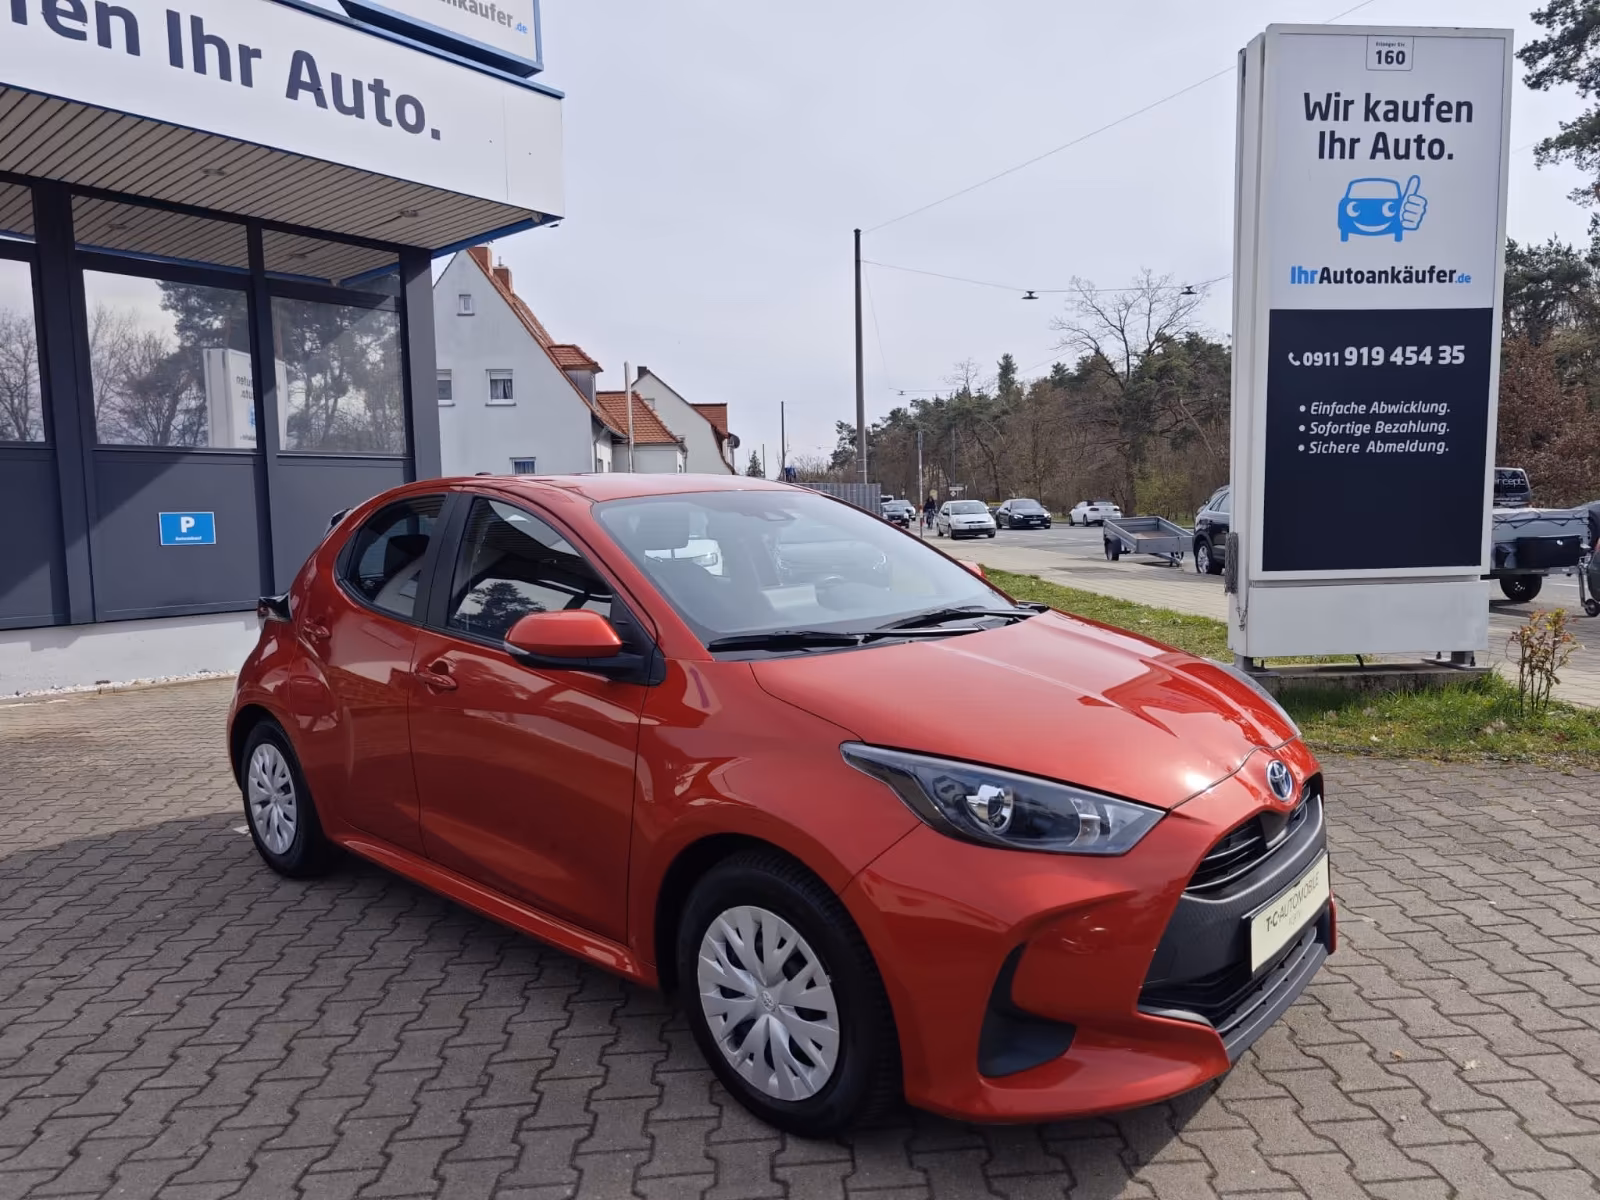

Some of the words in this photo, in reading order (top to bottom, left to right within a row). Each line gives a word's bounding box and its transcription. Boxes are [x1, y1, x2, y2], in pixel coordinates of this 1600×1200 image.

[1376, 50, 1406, 65] 160
[166, 9, 262, 88] Ihr
[286, 49, 441, 141] Auto.
[1303, 92, 1355, 122] Wir
[1364, 92, 1473, 123] kaufen
[1318, 130, 1361, 160] Ihr
[1369, 131, 1454, 160] Auto.
[1290, 265, 1472, 285] IhrAutoankäufer.de
[1302, 352, 1340, 367] 0911
[1344, 346, 1385, 366] 919
[1389, 346, 1433, 366] 454
[1438, 345, 1466, 365] 35
[1310, 402, 1367, 417] Einfache
[1369, 401, 1451, 416] Abwicklung.
[1309, 421, 1371, 437] Sofortige
[1374, 420, 1450, 435] Bezahlung.
[1309, 441, 1361, 454] Sichere
[1366, 440, 1449, 455] Abmeldung.
[181, 516, 195, 533] P
